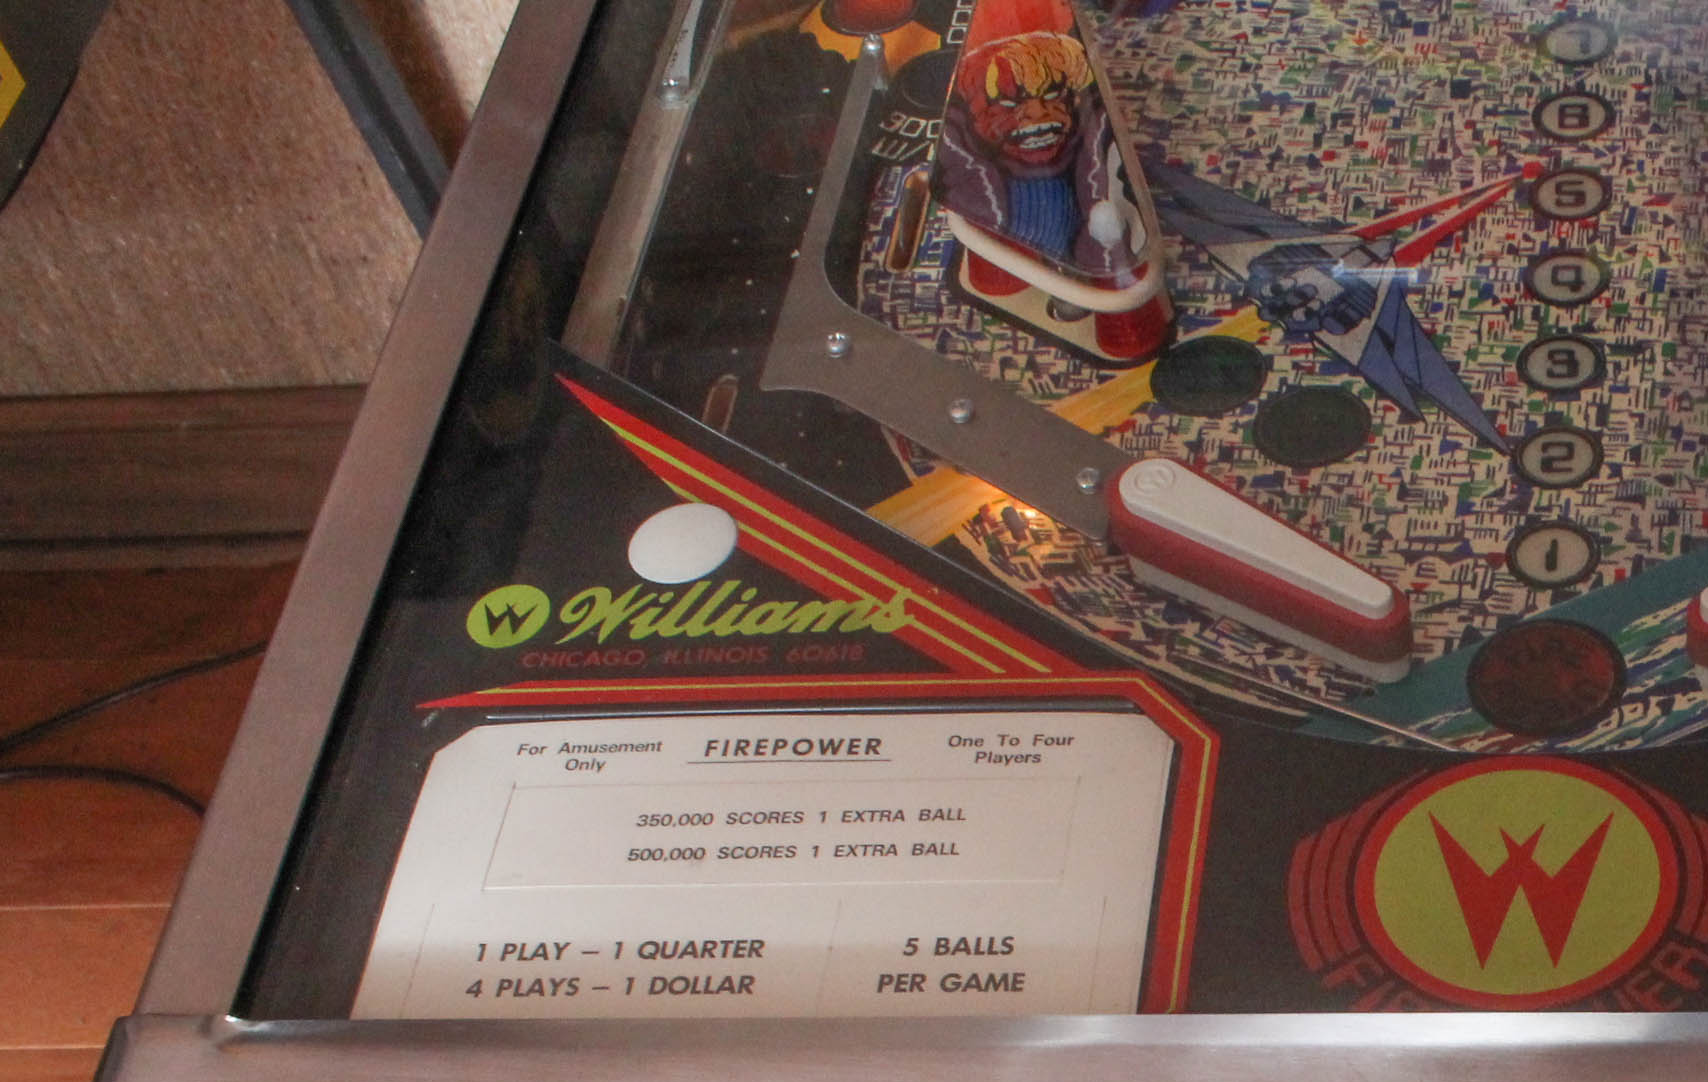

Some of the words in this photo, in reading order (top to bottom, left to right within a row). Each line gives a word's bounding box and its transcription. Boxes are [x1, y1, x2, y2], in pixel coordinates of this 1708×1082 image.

[1540, 440, 1577, 474] 2
[1544, 538, 1559, 572] 1
[555, 579, 914, 645] Williams
[663, 645, 770, 666] ILLINOIS
[785, 643, 866, 664] 60618
[516, 742, 549, 757] For
[556, 740, 663, 755] Amusement
[703, 737, 883, 758] FIREPOWER
[947, 733, 985, 749] One
[996, 733, 1021, 748] To
[1031, 732, 1075, 747] Four
[564, 757, 607, 774] Only
[973, 749, 1042, 767] Players
[635, 812, 715, 829] 350,000
[725, 809, 805, 826] SCORES
[819, 810, 828, 825] 1
[840, 808, 906, 824] EXTRA
[917, 807, 967, 823] BALL
[626, 846, 707, 863] 500,000
[715, 844, 798, 861] SCORES
[811, 844, 820, 860] 1
[832, 842, 899, 859] EXTRA
[911, 841, 960, 858] BALL
[476, 942, 488, 963] 1
[499, 941, 572, 962] PLAY
[614, 939, 624, 961] 1
[636, 938, 766, 961] QUARTER
[902, 936, 920, 958] 5
[933, 935, 1015, 957] BALLS
[464, 978, 483, 999] 4
[495, 976, 581, 998] PLAYS
[625, 975, 636, 996] 1
[647, 973, 756, 996] DOLLAR
[876, 972, 927, 994] PER
[939, 971, 1026, 994] GAME
